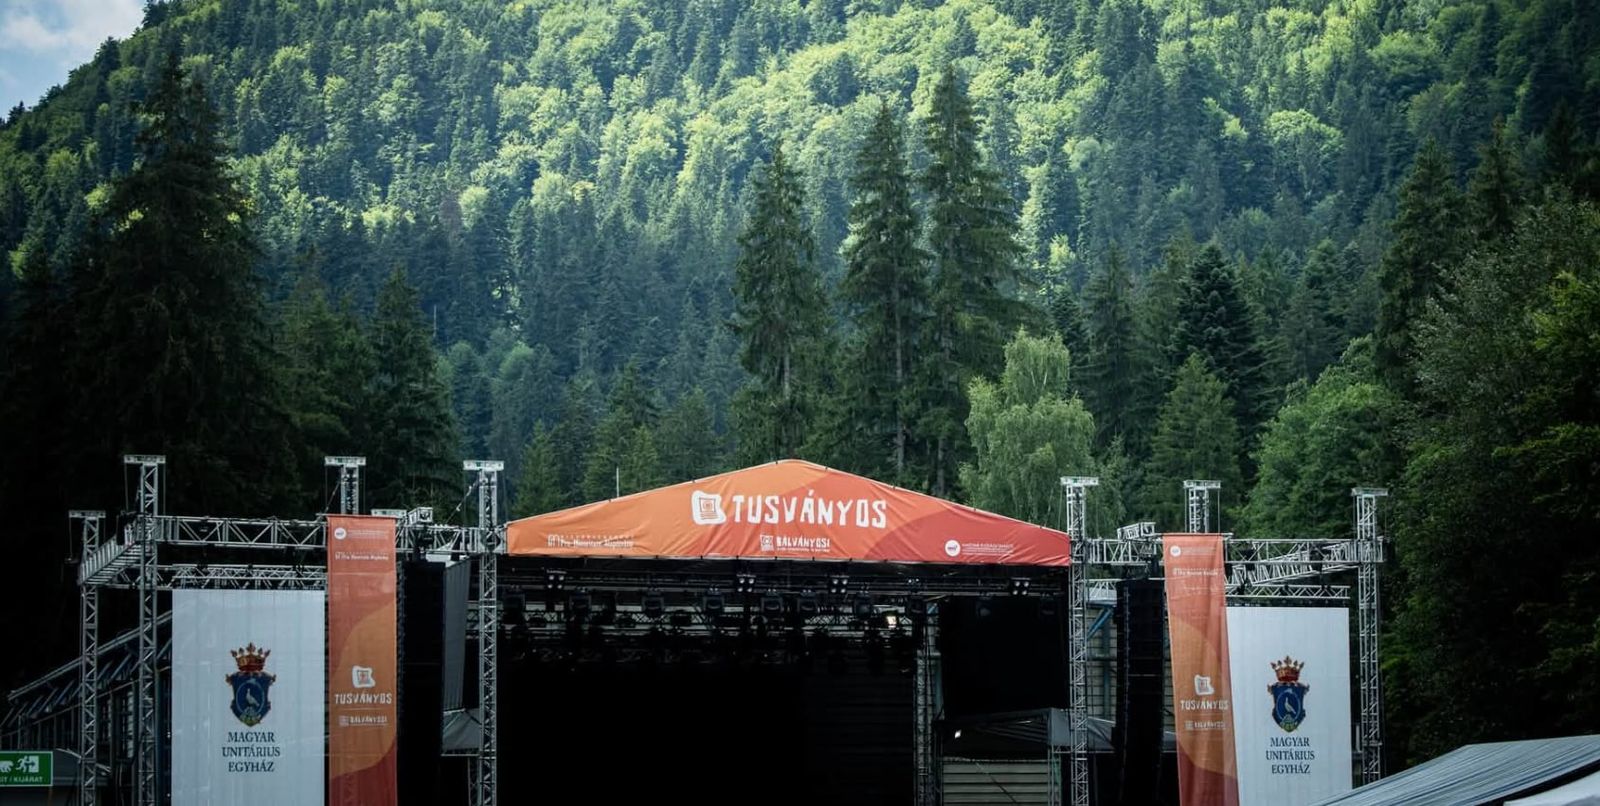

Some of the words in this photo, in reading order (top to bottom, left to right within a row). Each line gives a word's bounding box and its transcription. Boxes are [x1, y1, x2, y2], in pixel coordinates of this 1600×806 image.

[732, 490, 887, 529] TUSVÁNYOS
[334, 690, 393, 705] TUSVÁNYOS
[228, 731, 275, 743] MAGYAR
[1270, 736, 1311, 748] MAGYAR
[221, 743, 281, 758] UNITÁRIUS
[1265, 748, 1316, 761] UNITÁRIUS
[228, 759, 276, 773] EGYHÁZ
[1271, 762, 1311, 774] EGYHÁZ
